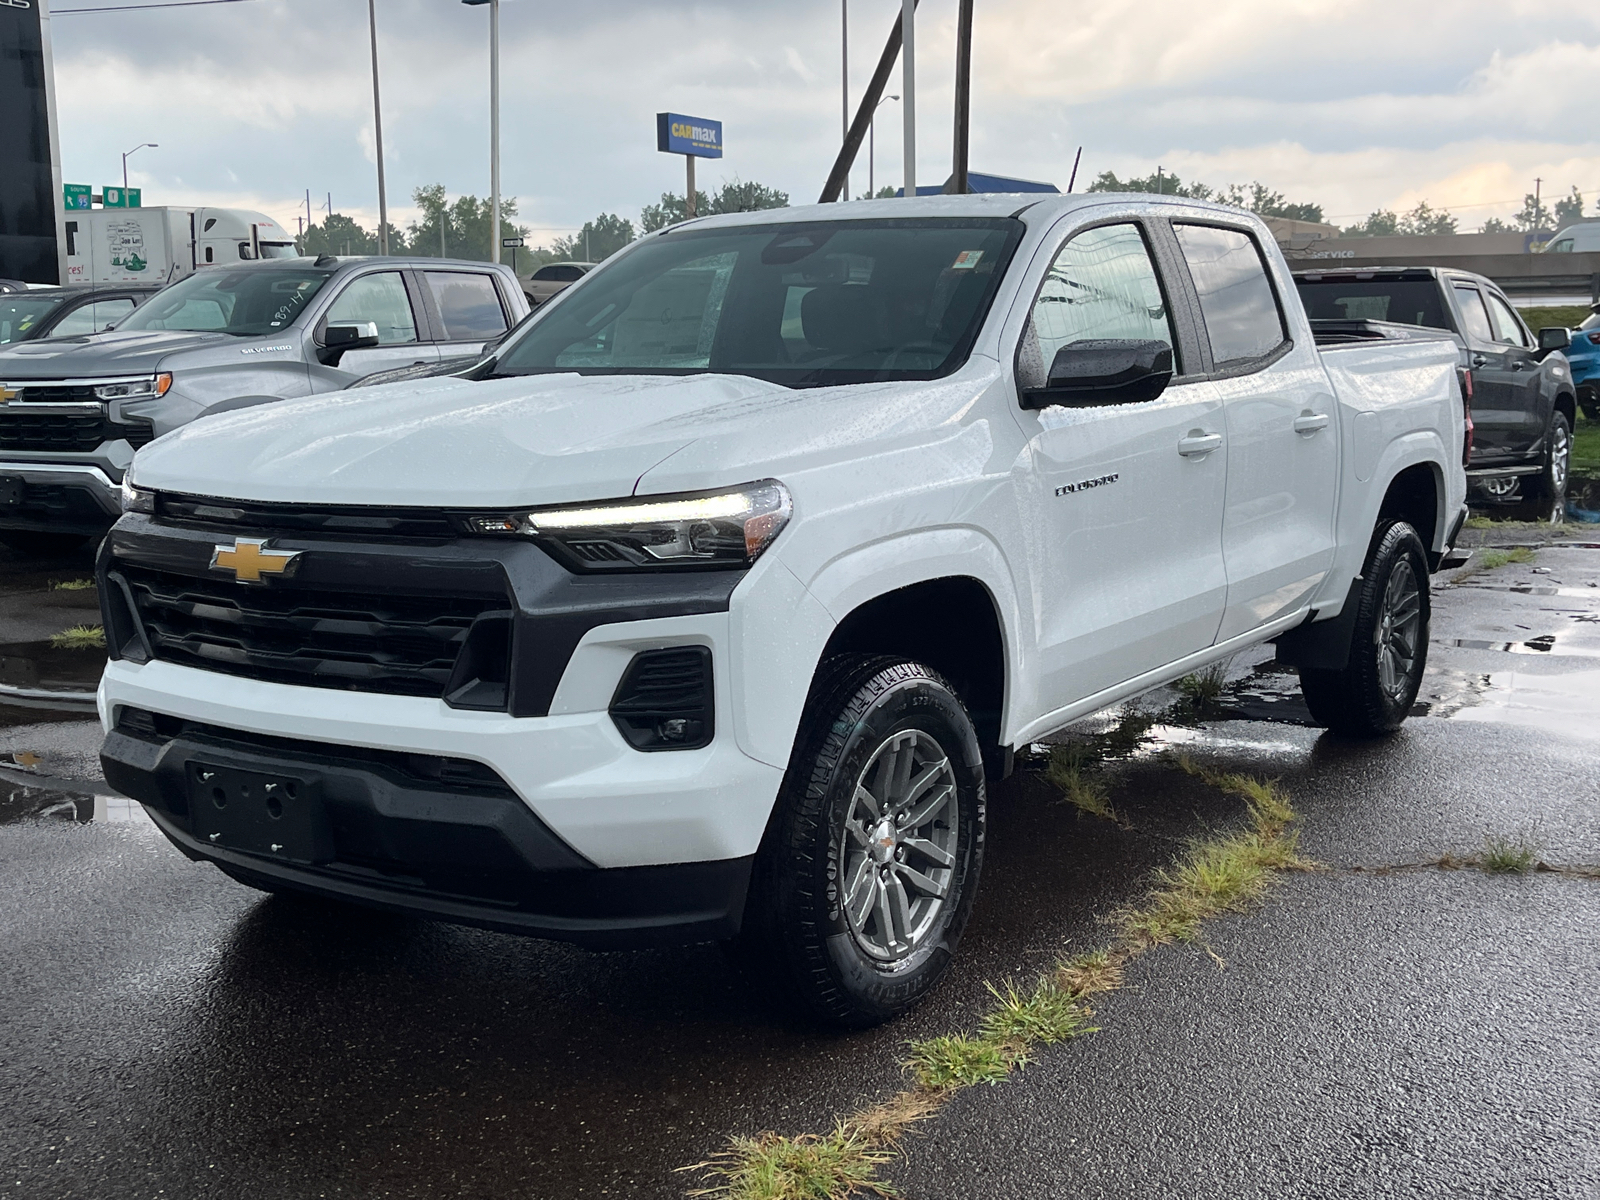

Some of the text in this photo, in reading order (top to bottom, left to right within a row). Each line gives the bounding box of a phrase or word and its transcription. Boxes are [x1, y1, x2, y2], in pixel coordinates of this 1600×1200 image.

[78, 198, 88, 207] 95
[241, 345, 292, 355] SILVERADO
[1055, 472, 1119, 496] COLORADO
